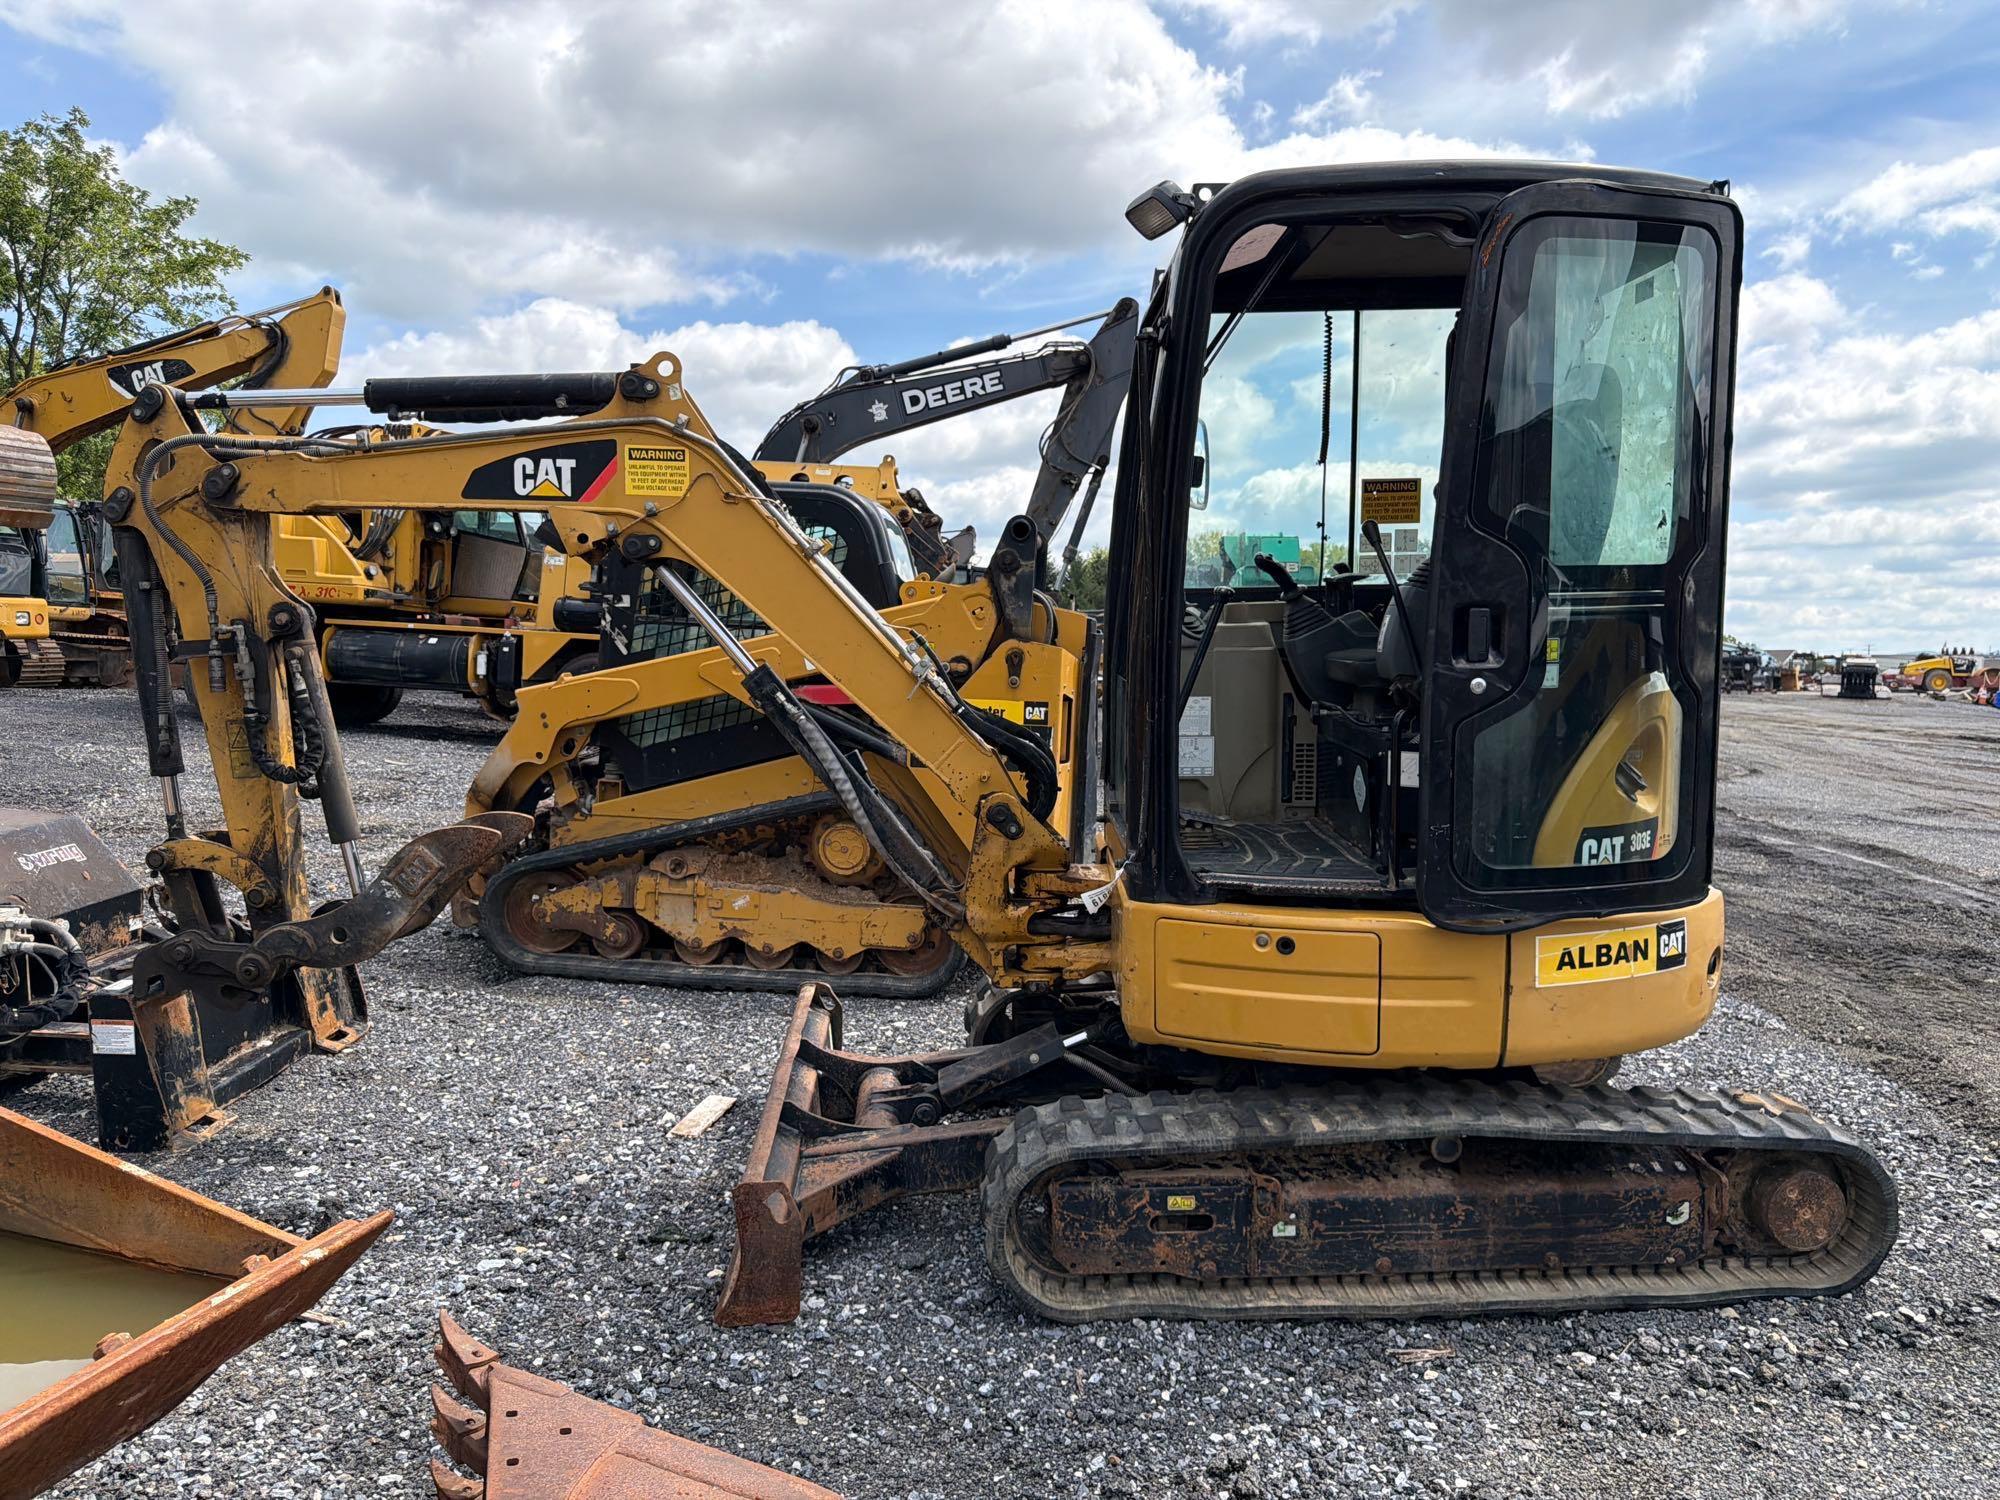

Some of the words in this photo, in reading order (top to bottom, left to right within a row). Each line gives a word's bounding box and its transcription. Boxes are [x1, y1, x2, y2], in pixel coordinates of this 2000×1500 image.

[131, 361, 166, 393] CAT
[902, 371, 1003, 414] DEERE
[630, 450, 684, 460] WARNING
[514, 457, 576, 497] CAT
[1365, 482, 1416, 491] WARNING
[1025, 706, 1046, 720] CAT
[1581, 836, 1624, 866] CAT
[1630, 830, 1651, 853] 303E
[1556, 938, 1649, 971] ALBAN
[1660, 930, 1685, 958] CAT
